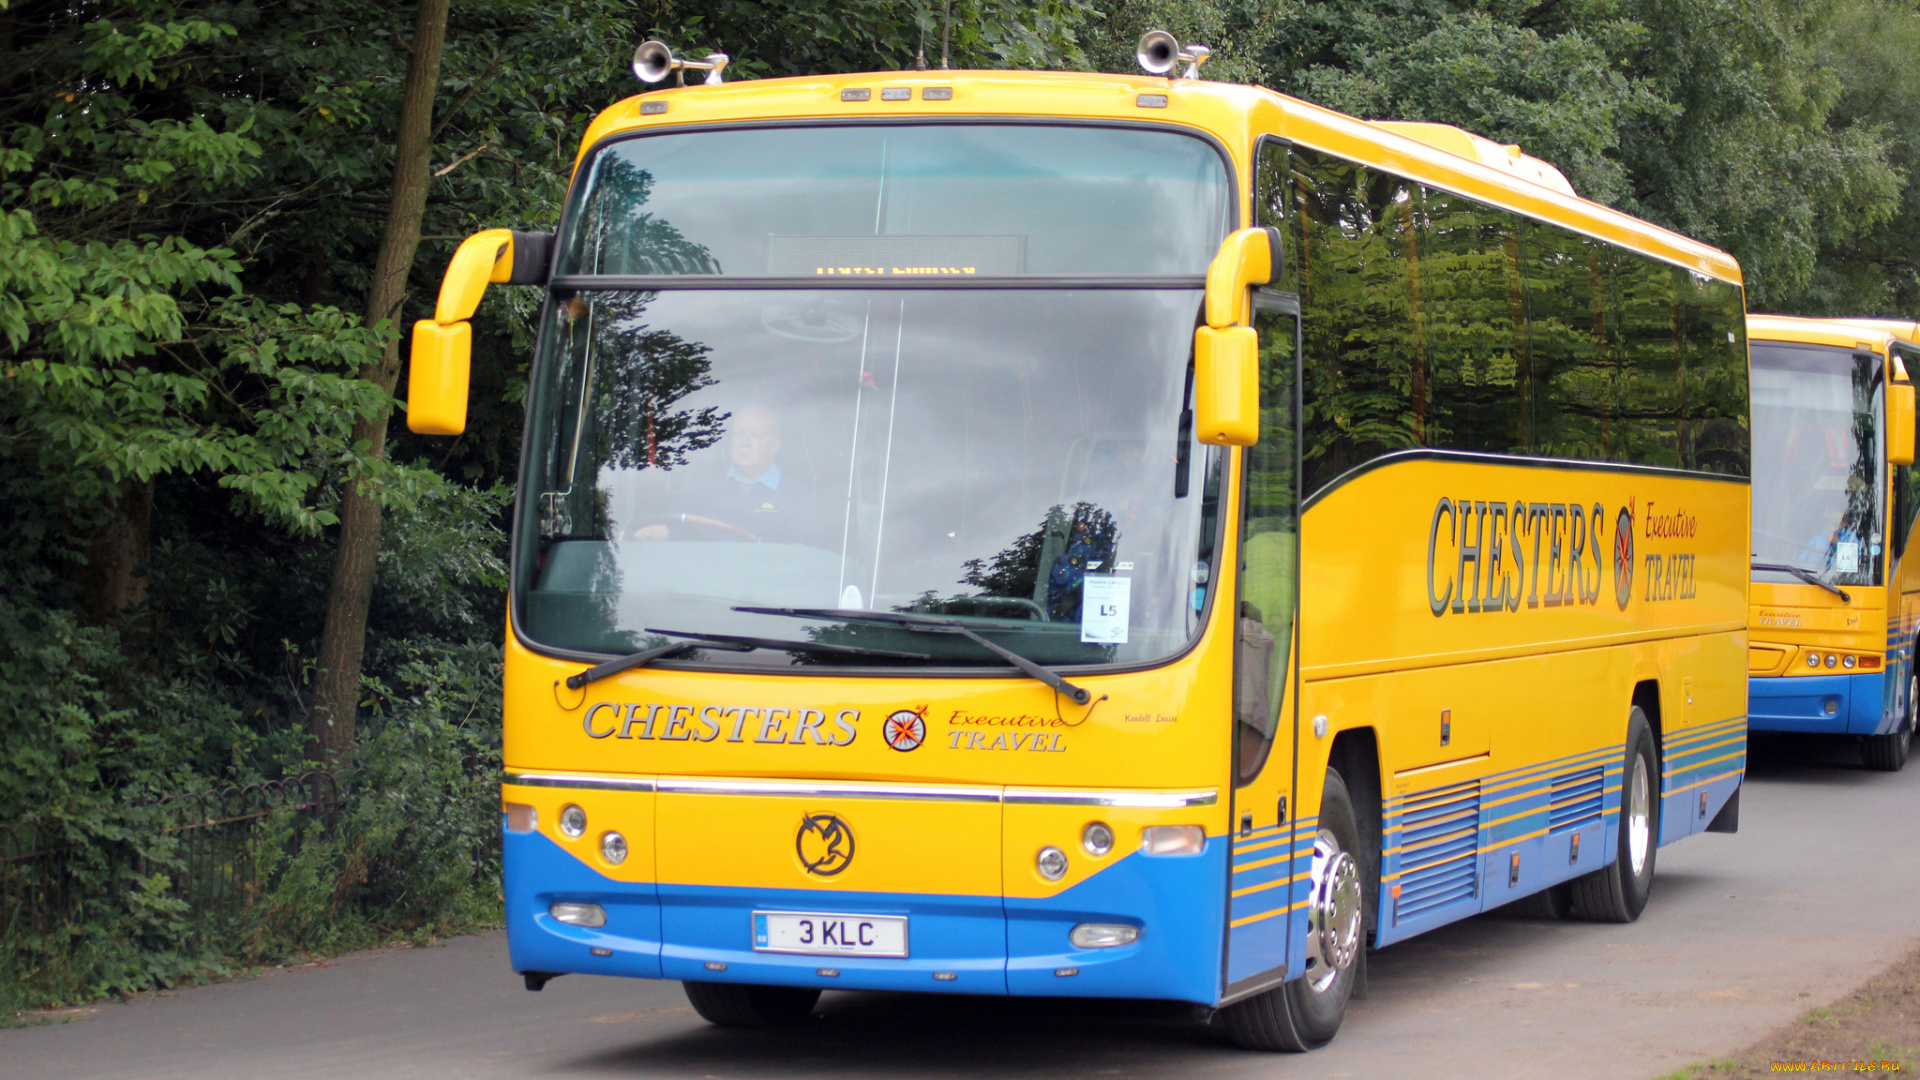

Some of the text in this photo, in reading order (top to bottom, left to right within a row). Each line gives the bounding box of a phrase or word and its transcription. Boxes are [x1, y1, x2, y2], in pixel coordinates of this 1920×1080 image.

[1645, 501, 1697, 540] Executive
[1427, 496, 1604, 618] CHESTERS
[1645, 554, 1697, 602] TRAVEL
[1100, 604, 1117, 617] L5
[1758, 617, 1802, 627] TRAVEL
[583, 701, 861, 747] CHESTERS
[949, 710, 1068, 728] Executive
[948, 730, 1067, 752] TRAVEL
[799, 920, 874, 946] 3 KLC
